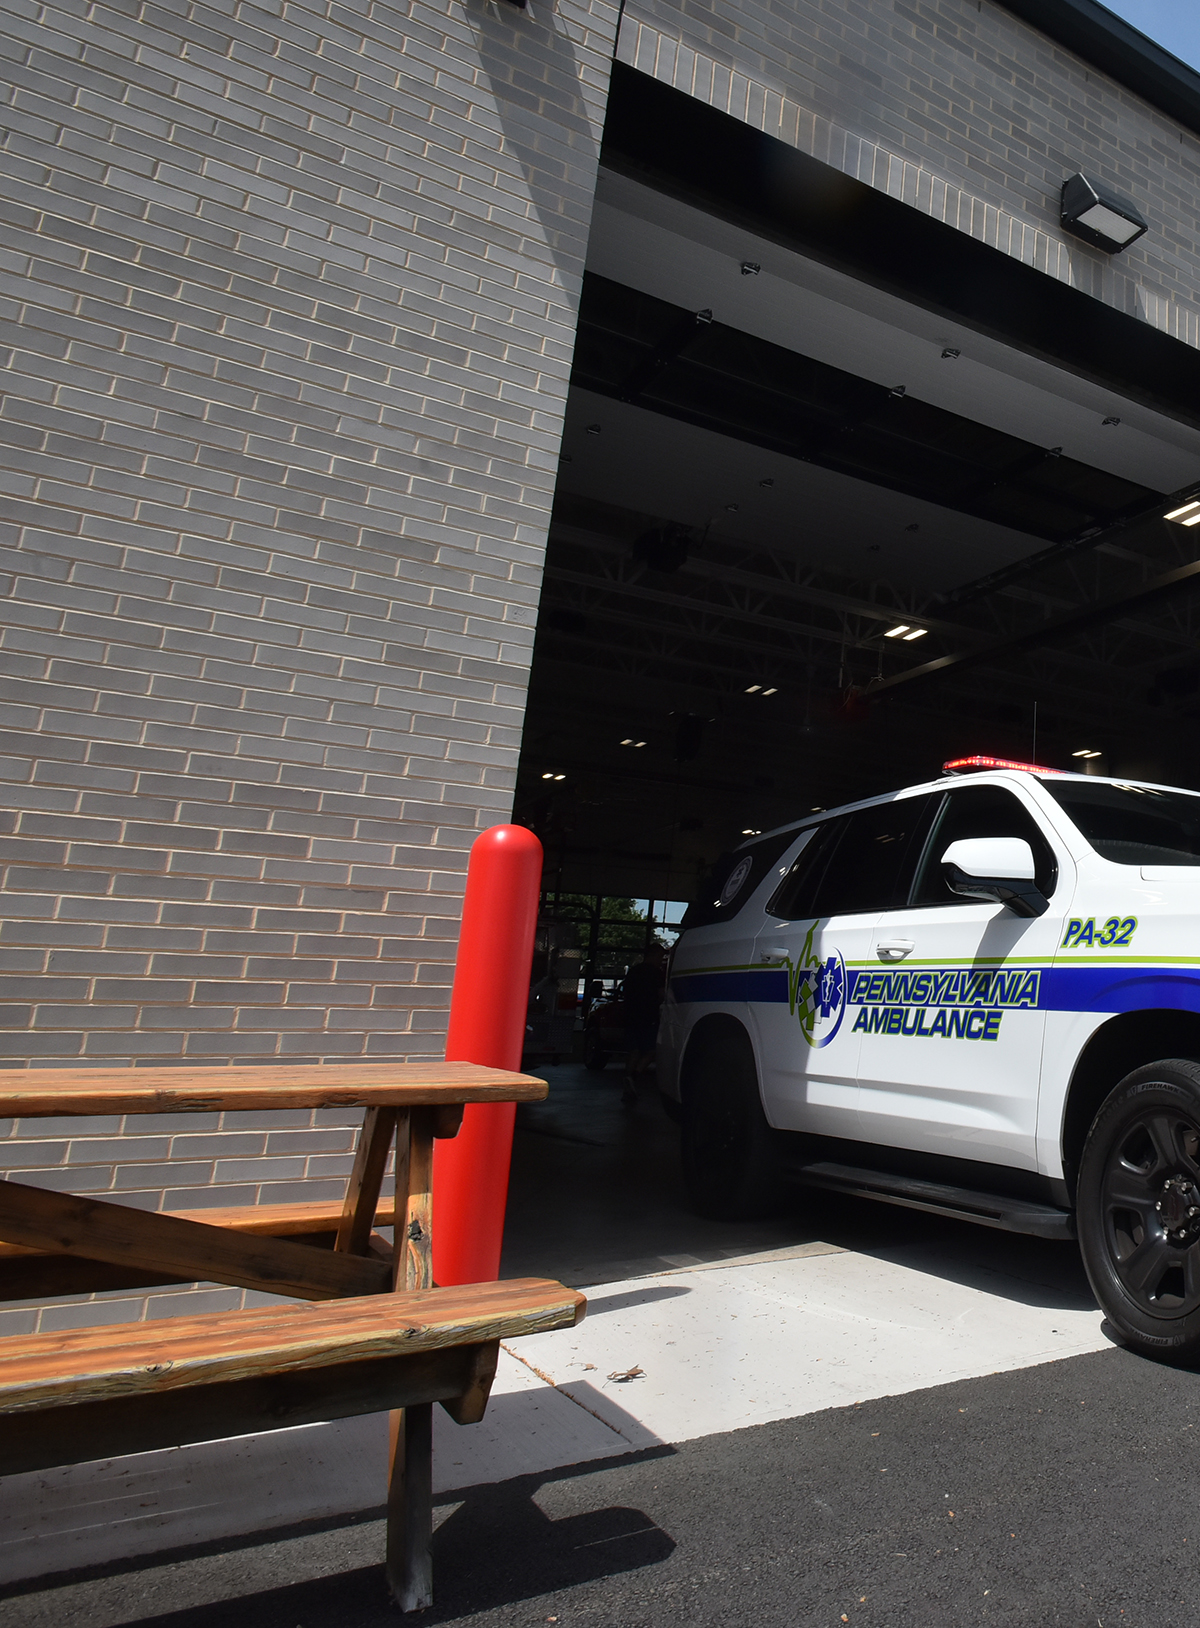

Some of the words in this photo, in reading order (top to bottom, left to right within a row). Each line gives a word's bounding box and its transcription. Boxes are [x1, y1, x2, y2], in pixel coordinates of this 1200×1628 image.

[1060, 916, 1138, 948] PA-32
[851, 971, 1041, 1006] PENNSYLVANIA
[851, 1007, 1004, 1041] AMBULANCE
[1141, 1083, 1180, 1094] FIREHAWK
[1131, 1328, 1169, 1345] FIREHAW
